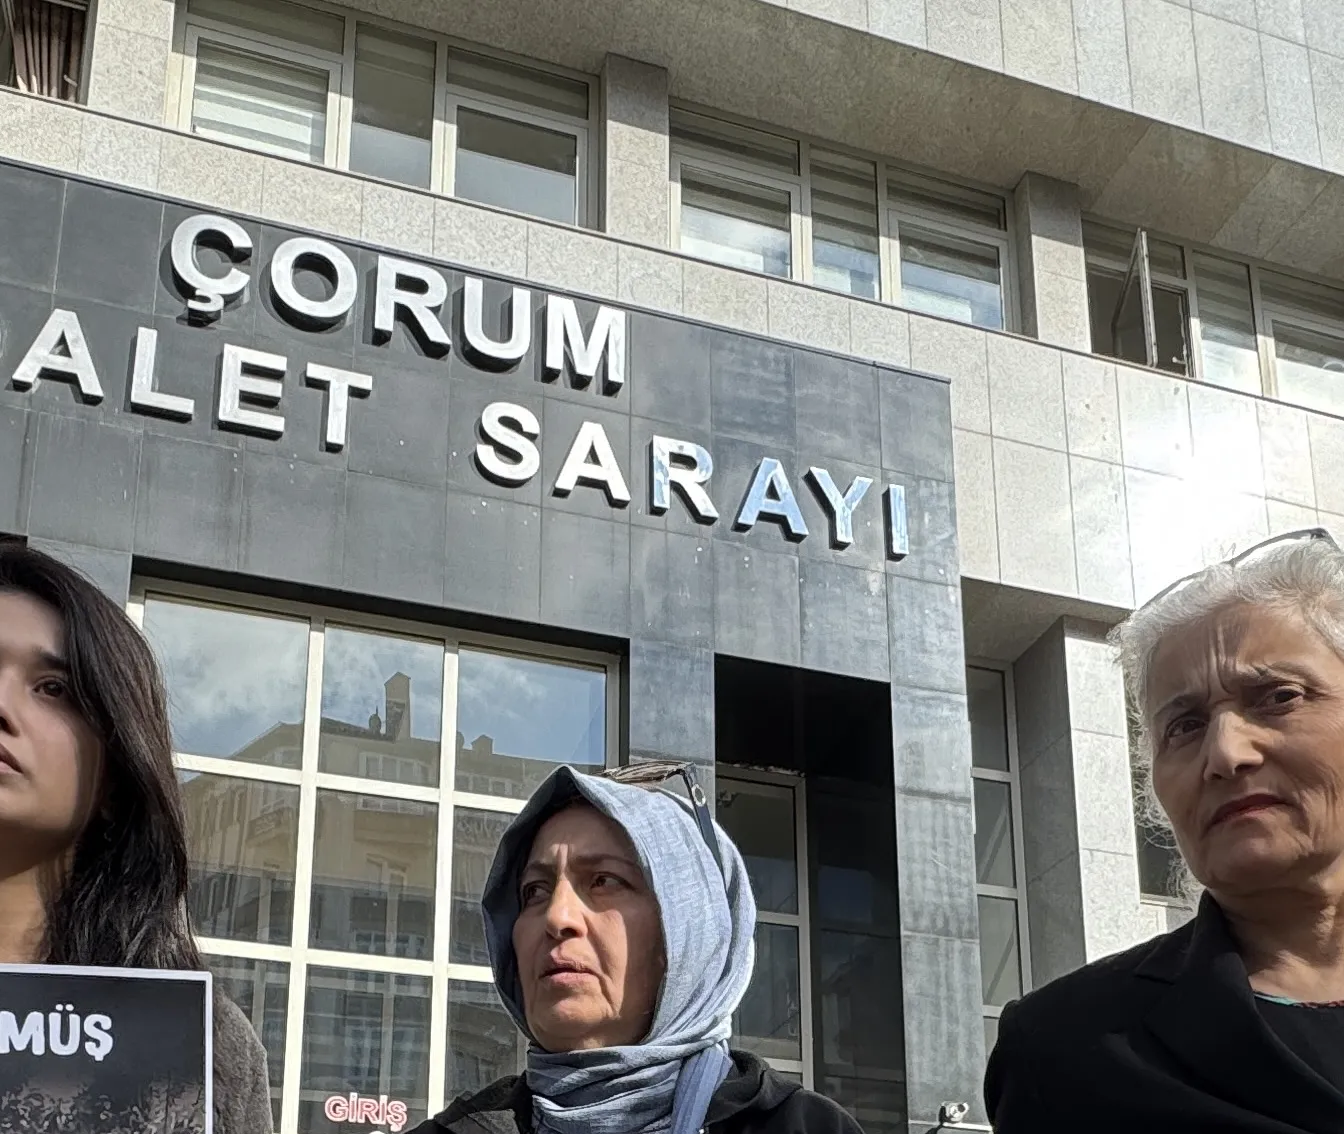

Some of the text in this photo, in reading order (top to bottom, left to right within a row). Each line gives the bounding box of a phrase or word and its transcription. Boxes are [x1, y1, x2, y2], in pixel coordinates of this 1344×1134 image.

[171, 213, 626, 394] ÇORUM
[476, 402, 910, 559] SARAYI
[325, 1092, 407, 1132] GİRİŞ
